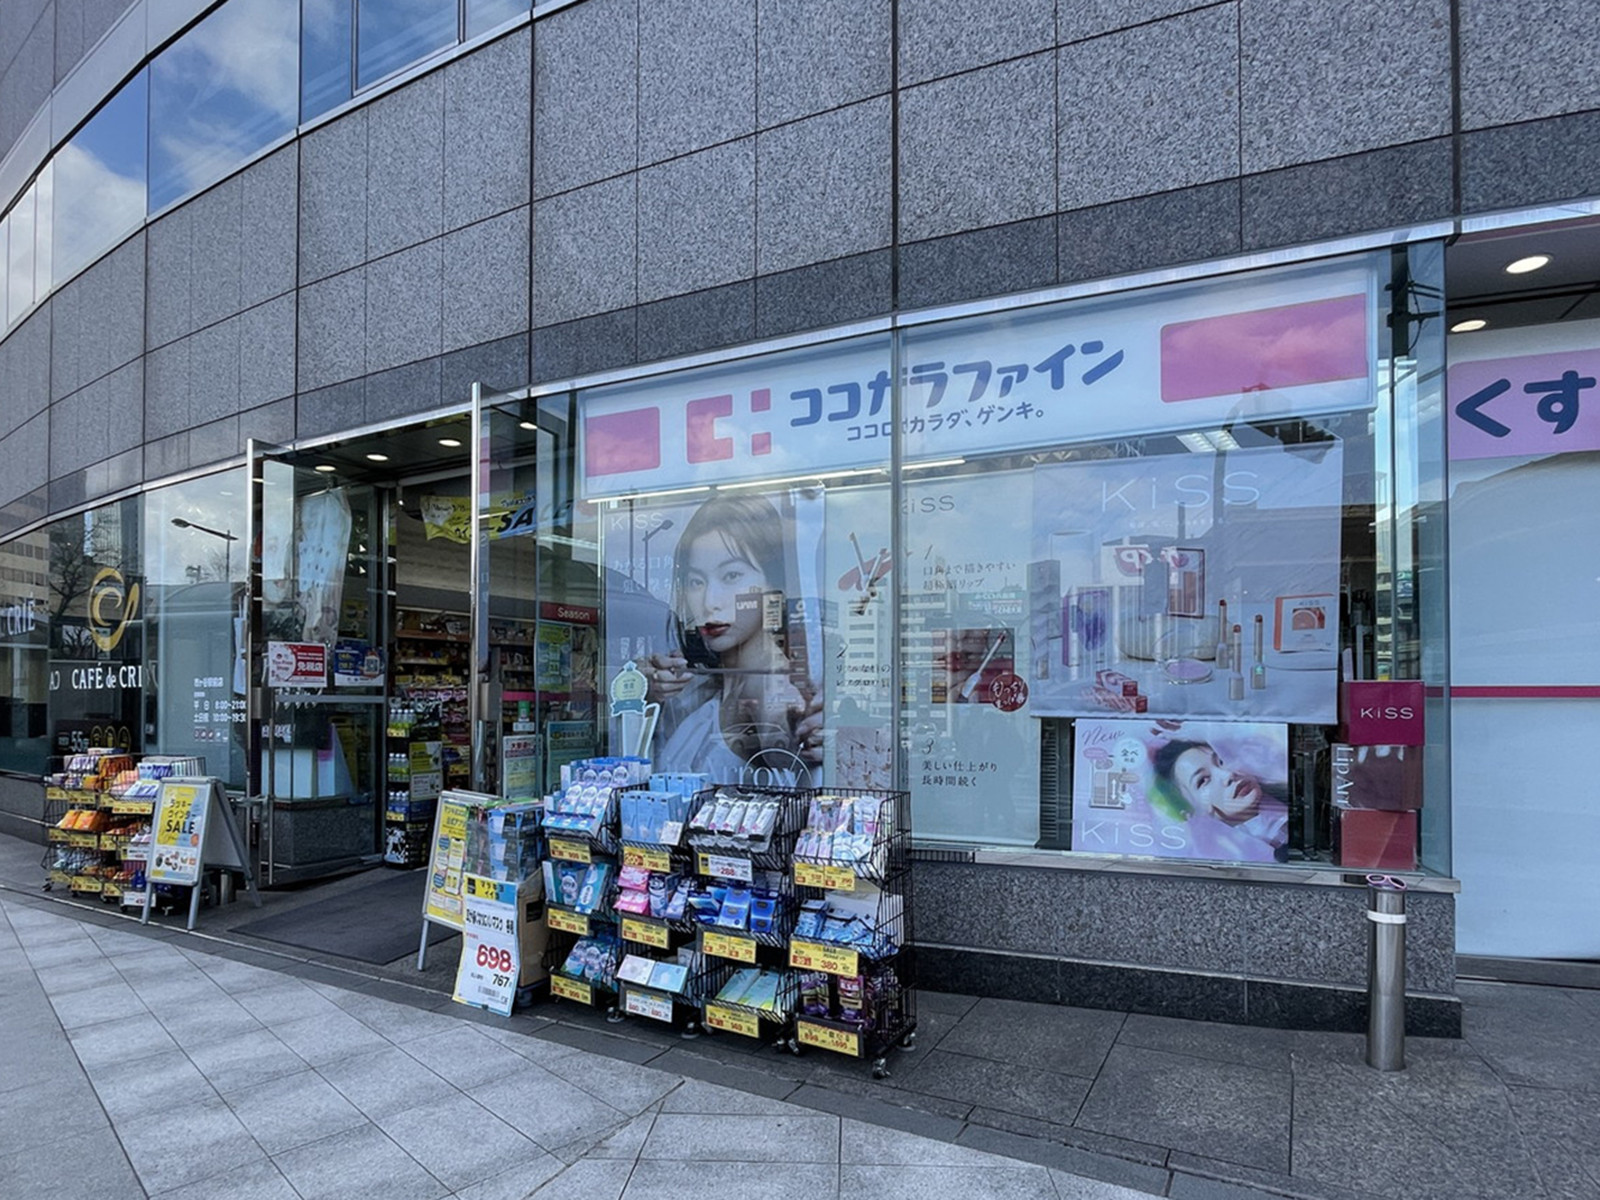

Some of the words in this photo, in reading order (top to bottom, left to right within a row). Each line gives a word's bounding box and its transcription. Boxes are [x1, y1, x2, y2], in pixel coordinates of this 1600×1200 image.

[1455, 369, 1597, 438] くす
[847, 402, 1044, 441] ココロカラダ、ゲンキ。
[557, 607, 590, 620] Season
[72, 661, 104, 690] CAFÉ
[106, 666, 117, 689] de
[1361, 707, 1414, 720] KiSS
[922, 760, 998, 774] 美しい仕上がり
[922, 774, 977, 787] 長時間続く
[165, 819, 196, 835] SALE
[1081, 823, 1187, 850] KiSS
[476, 943, 512, 973] 698
[492, 973, 510, 987] 767
